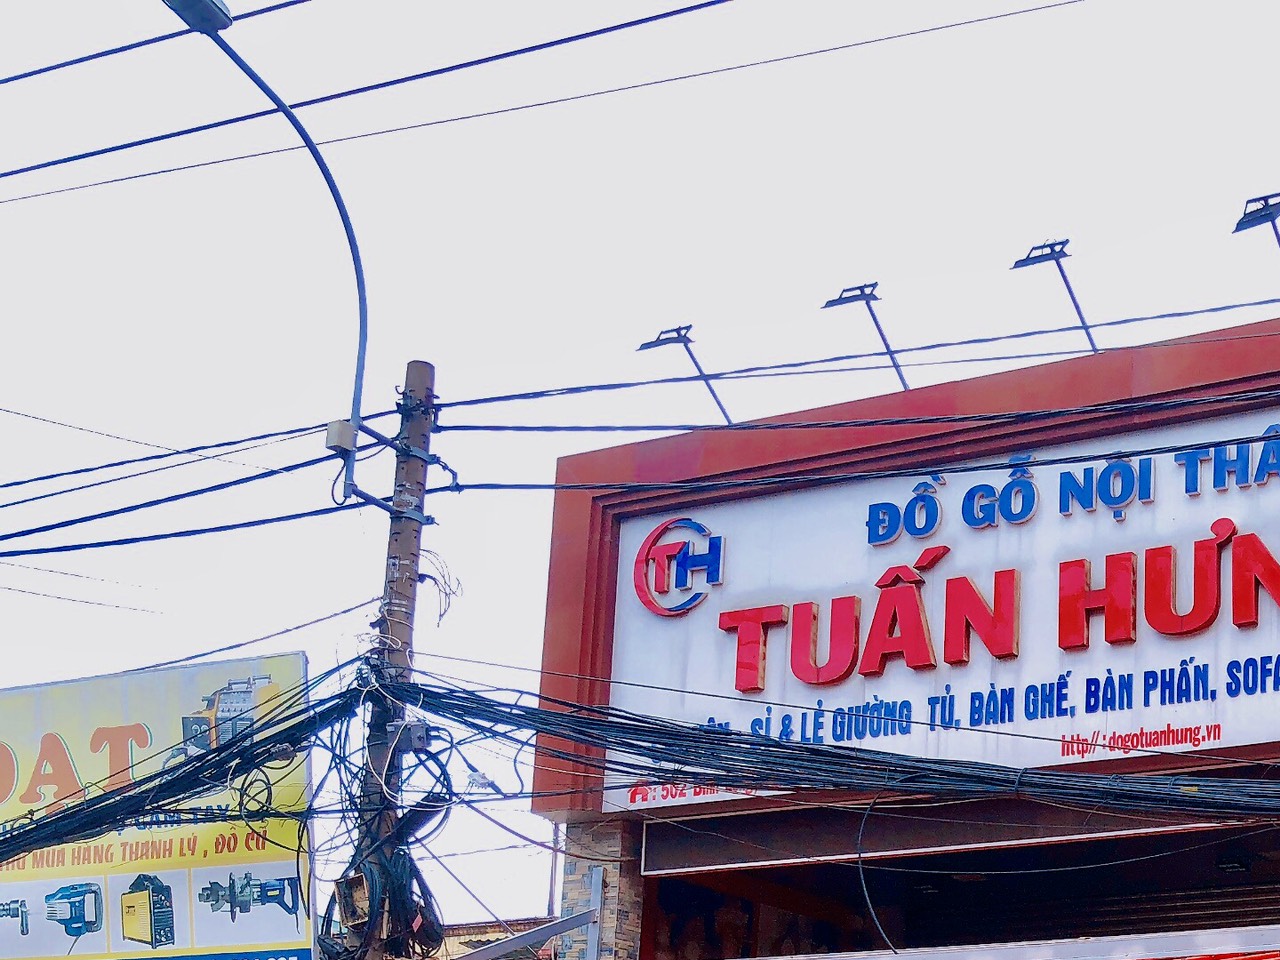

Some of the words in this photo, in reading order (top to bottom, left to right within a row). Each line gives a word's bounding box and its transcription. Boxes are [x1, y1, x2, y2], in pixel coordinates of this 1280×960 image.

[866, 474, 946, 545] ĐỒ
[962, 454, 1040, 529] GỖ
[1059, 450, 1154, 522] NỘI
[718, 545, 1021, 693] TUẤN
[800, 698, 824, 744] LẺ
[832, 694, 912, 743] GIƯỜNG
[928, 683, 961, 732] TỦ,
[969, 682, 1015, 727] BÀN
[1024, 670, 1076, 719] GHẾ,
[1085, 668, 1134, 714] BÀN
[1143, 656, 1217, 708] PHẤN,
[32, 847, 66, 869] MUA
[120, 838, 173, 863] THANH
[179, 833, 198, 857] LÝ
